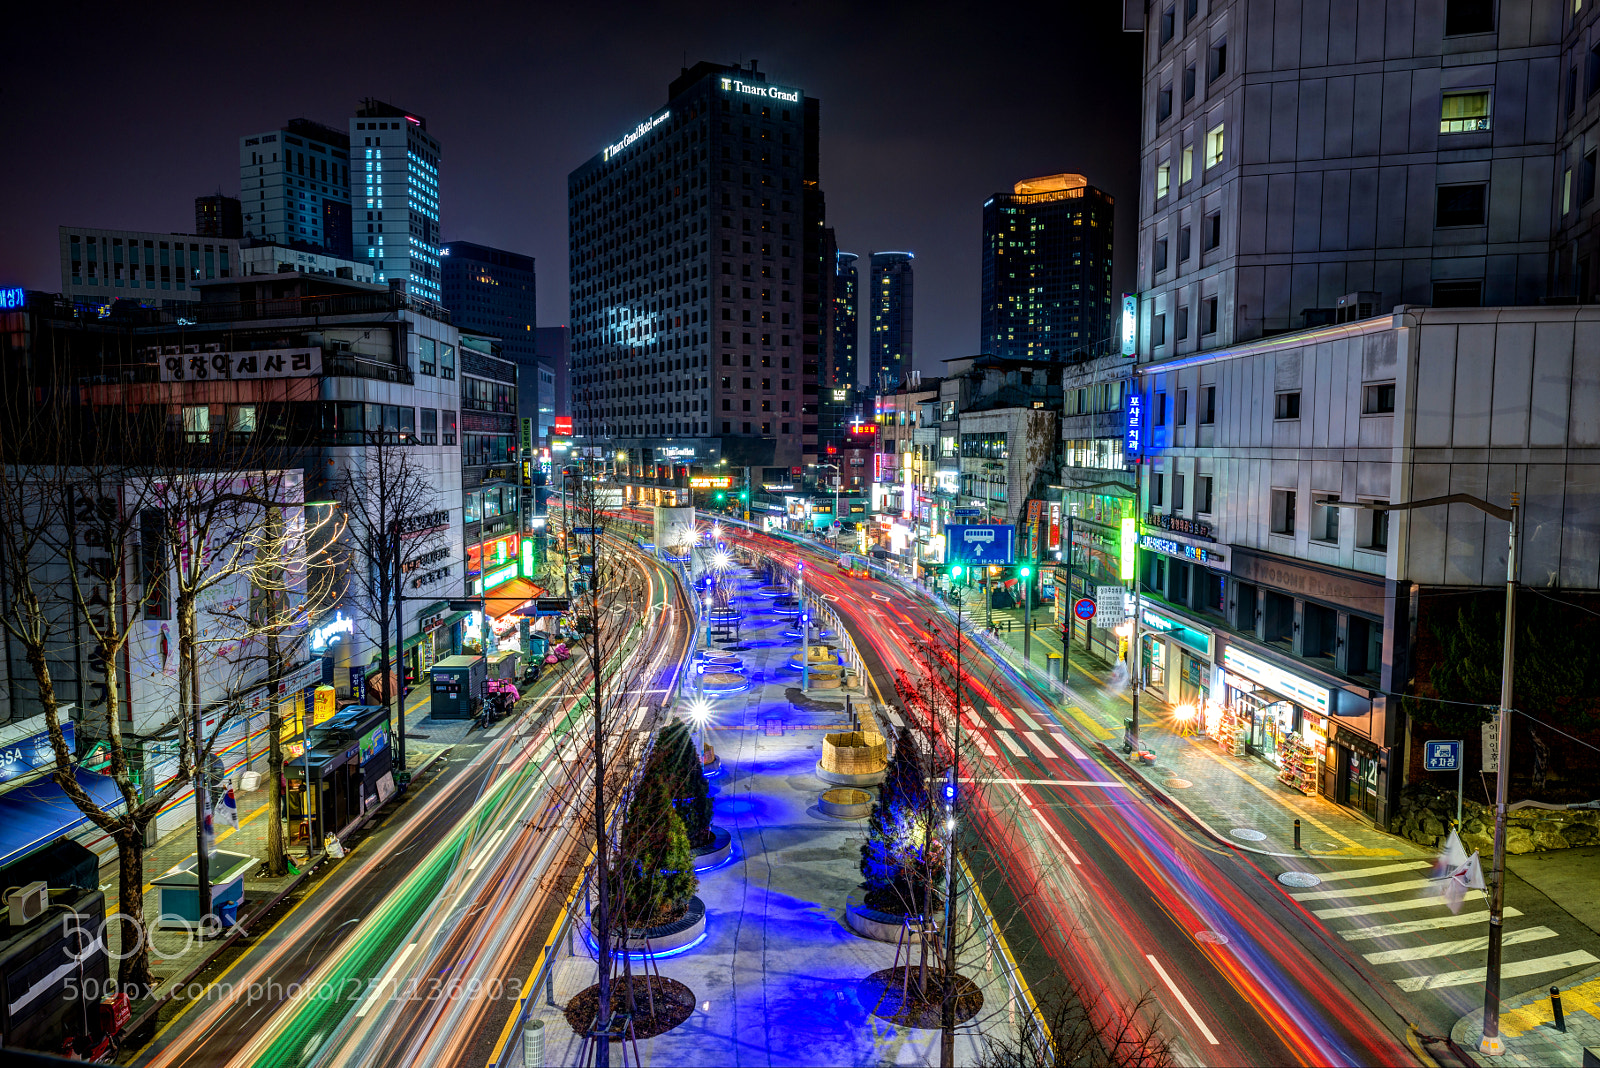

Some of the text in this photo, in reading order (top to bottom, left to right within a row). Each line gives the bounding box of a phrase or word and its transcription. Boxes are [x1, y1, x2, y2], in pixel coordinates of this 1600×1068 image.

[734, 80, 767, 96] Tmark
[769, 87, 798, 102] Grand
[609, 140, 624, 157] Tmark
[624, 128, 639, 147] Grand
[638, 117, 653, 137] Hotel
[1129, 396, 1140, 427] 포샤르
[1128, 430, 1140, 451] 치과
[1430, 755, 1456, 767] 주차장
